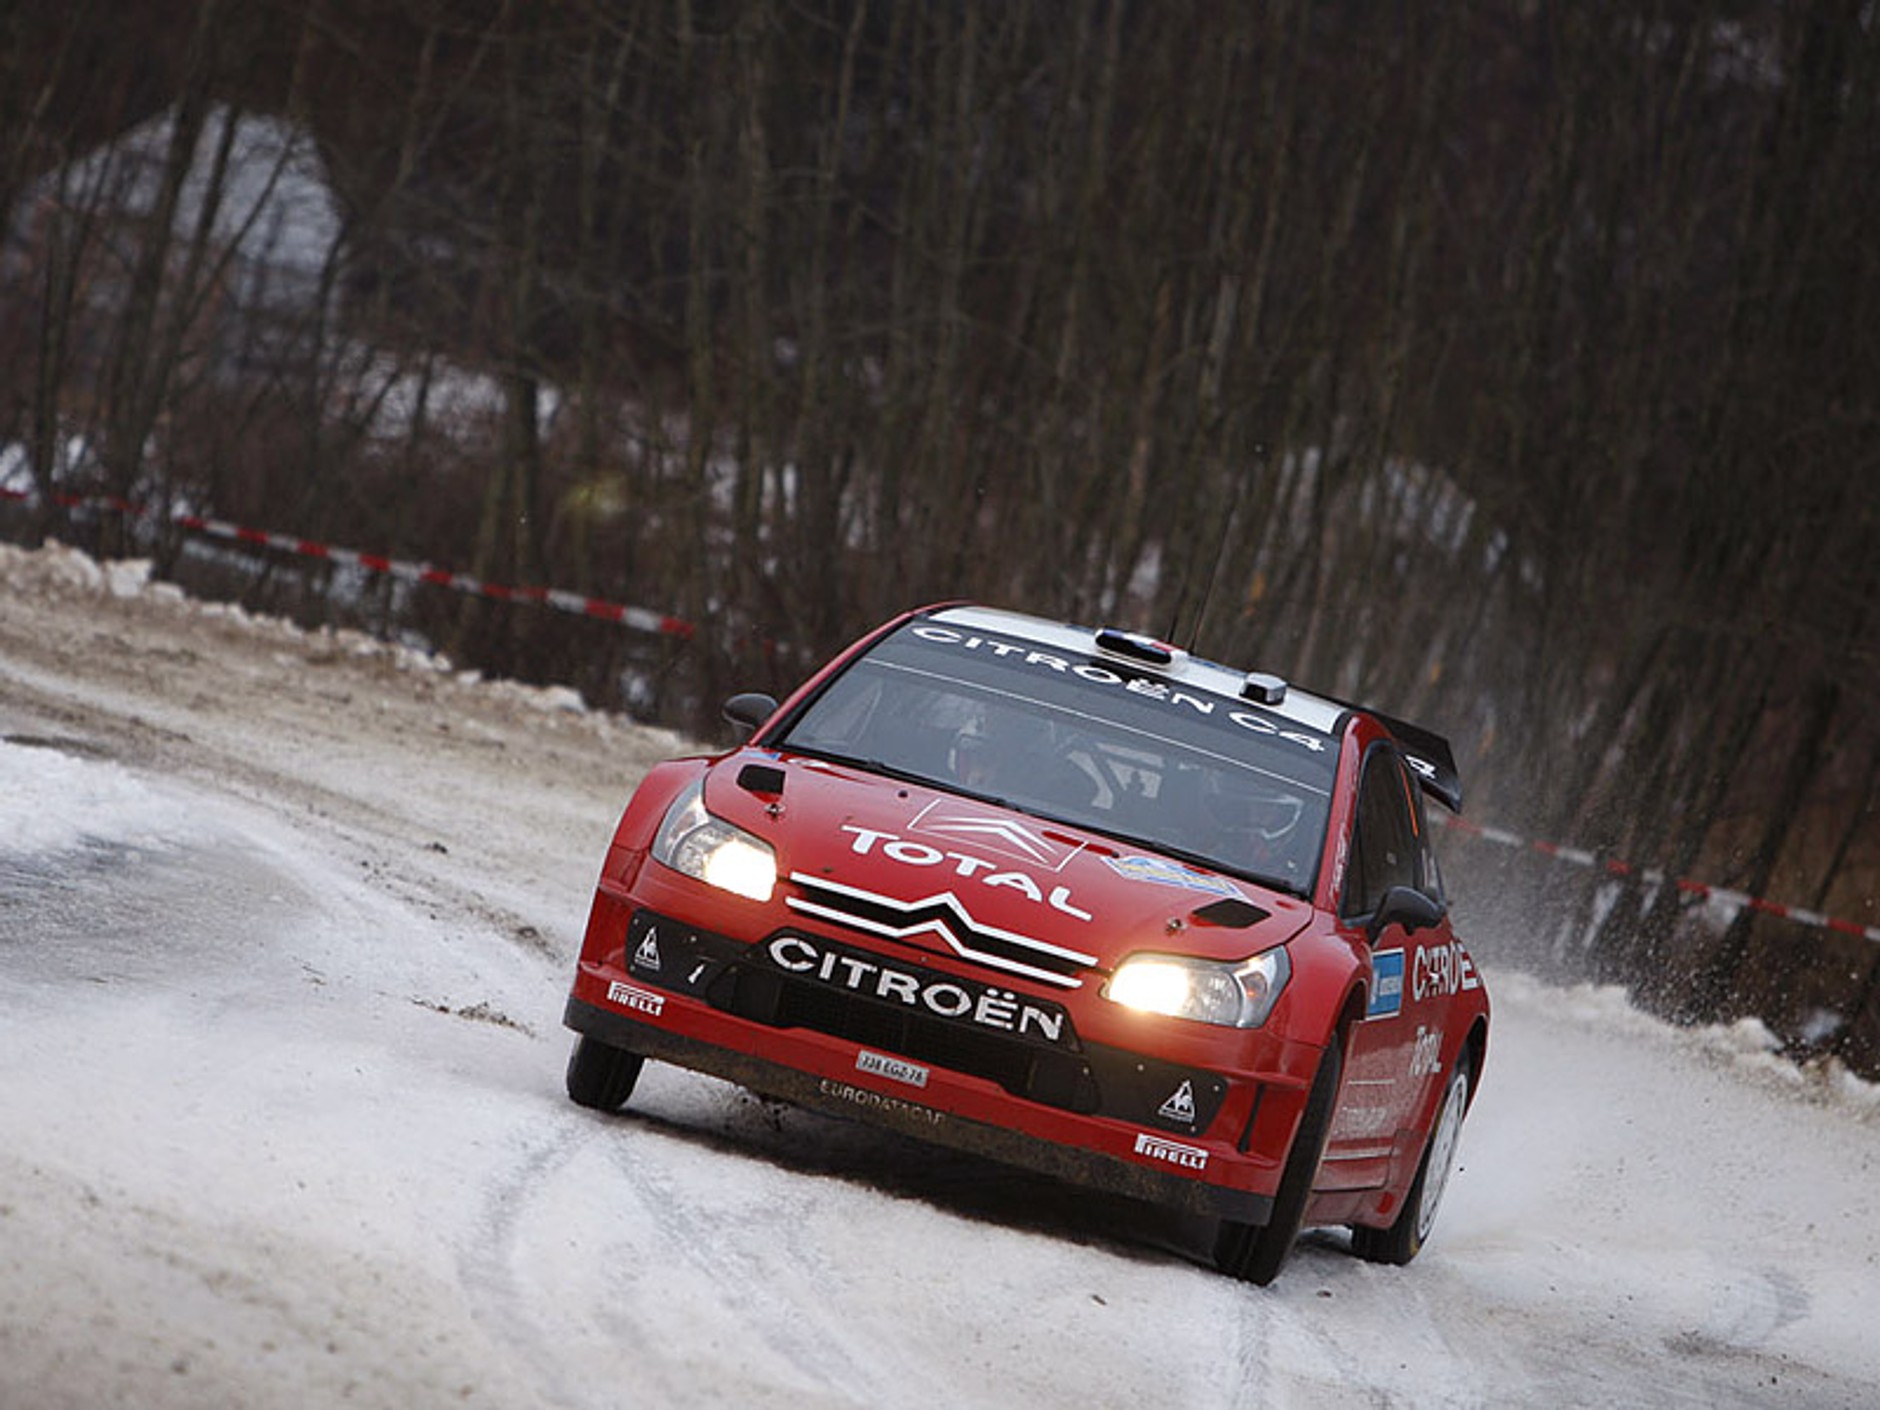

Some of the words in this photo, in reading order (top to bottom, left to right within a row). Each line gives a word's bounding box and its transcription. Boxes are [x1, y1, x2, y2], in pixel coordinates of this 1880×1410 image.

[910, 624, 1215, 715] CITROËN
[1229, 710, 1326, 754] C4
[840, 823, 1093, 922] TOTAL
[607, 980, 666, 1016] PIRELLI
[768, 936, 1065, 1042] CITROËN
[1134, 1132, 1209, 1170] PIRELLI
